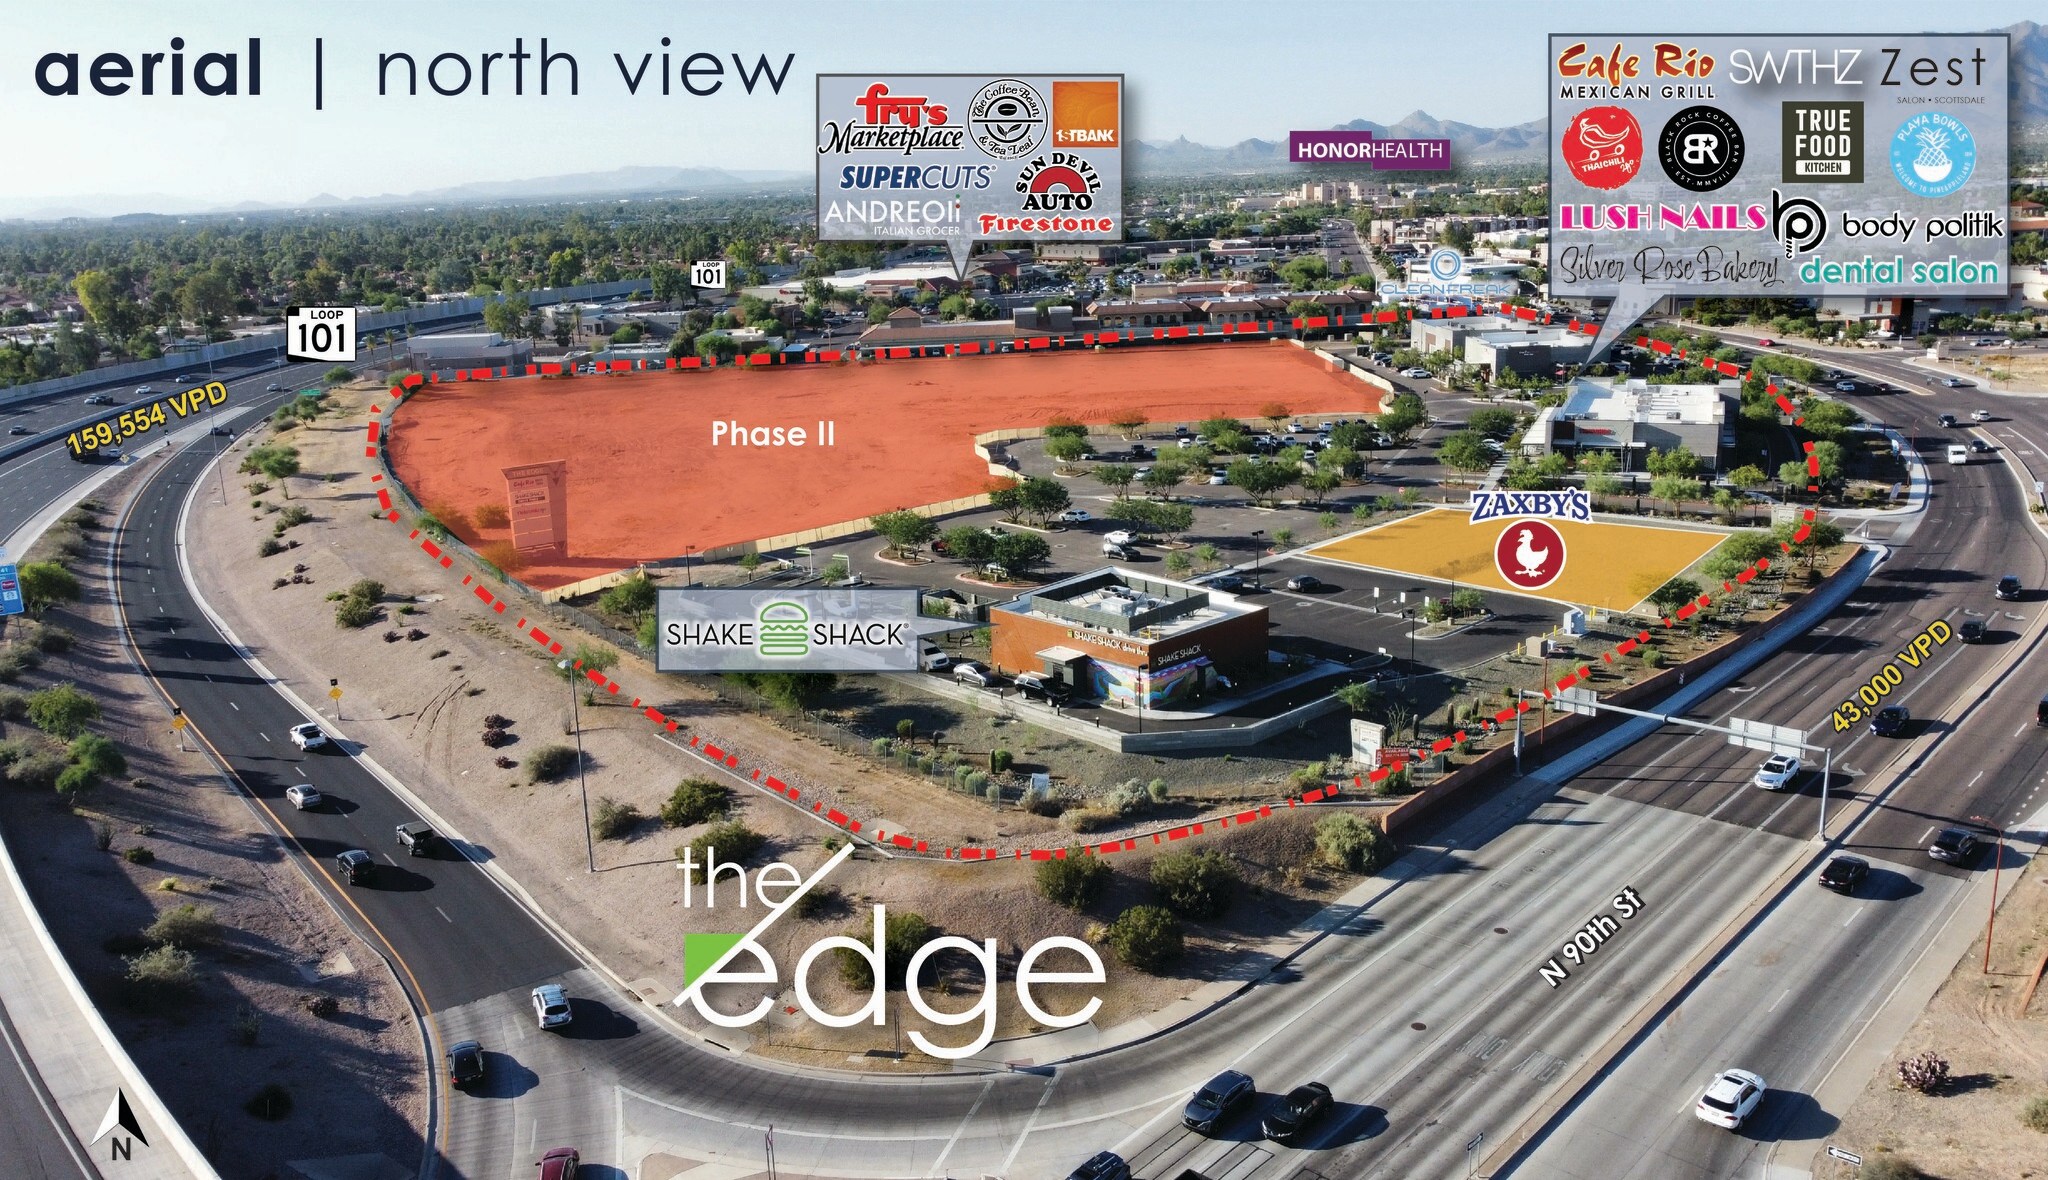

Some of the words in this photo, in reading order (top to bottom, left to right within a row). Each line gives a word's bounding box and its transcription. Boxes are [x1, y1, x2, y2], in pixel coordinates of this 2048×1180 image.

[1073, 631, 1097, 644] SHAKE
[1098, 636, 1122, 650] SHACK
[1157, 651, 1180, 666] SHAKE
[1180, 644, 1202, 658] SHACK
